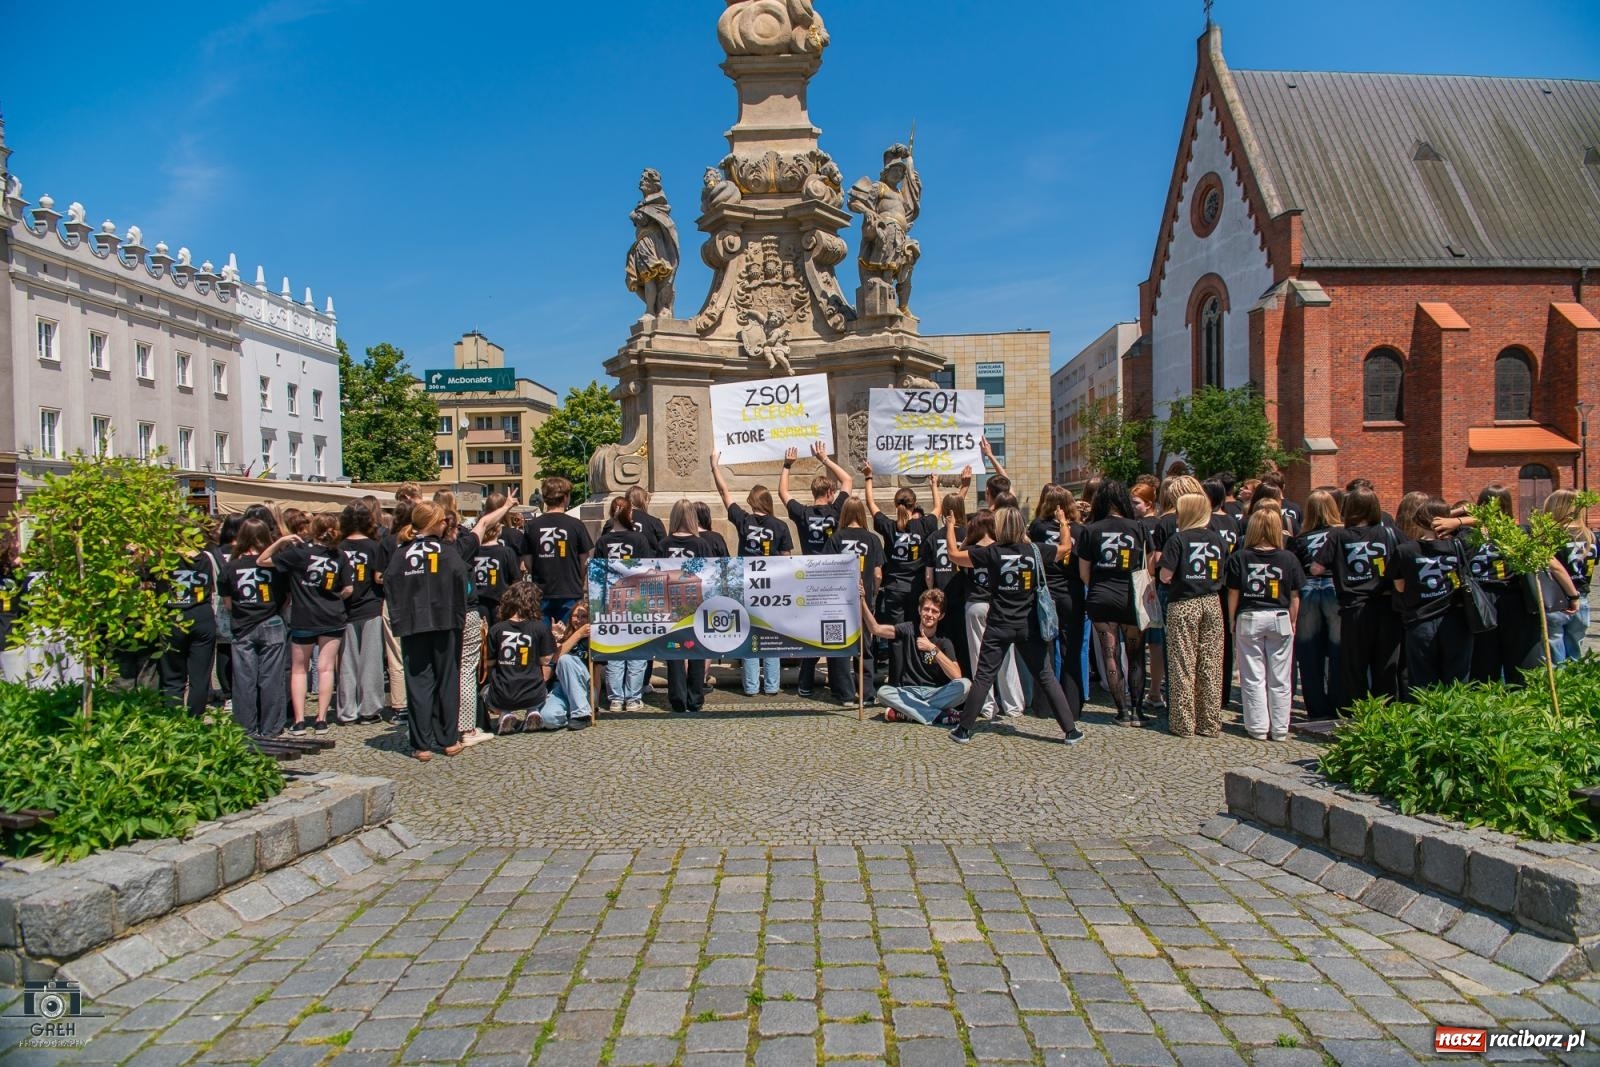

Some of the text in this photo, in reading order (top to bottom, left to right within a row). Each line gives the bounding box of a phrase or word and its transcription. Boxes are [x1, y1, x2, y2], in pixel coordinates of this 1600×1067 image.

[448, 376, 492, 384] McDonald's
[876, 433, 975, 451] GDZIE JESTEŚ
[540, 527, 568, 542] ZS
[1101, 532, 1134, 550] ZS
[1190, 542, 1221, 560] ZS
[1344, 541, 1386, 560] ZS
[749, 560, 767, 572] 12
[1001, 555, 1035, 574] ZS
[1248, 564, 1282, 581] ZS
[236, 568, 272, 587] ZS
[749, 577, 771, 589] XII
[750, 595, 792, 607] 2025
[593, 611, 672, 623] Jubileusz
[713, 615, 729, 627] 80
[598, 624, 667, 635] 80-lecia
[501, 631, 532, 648] ZS
